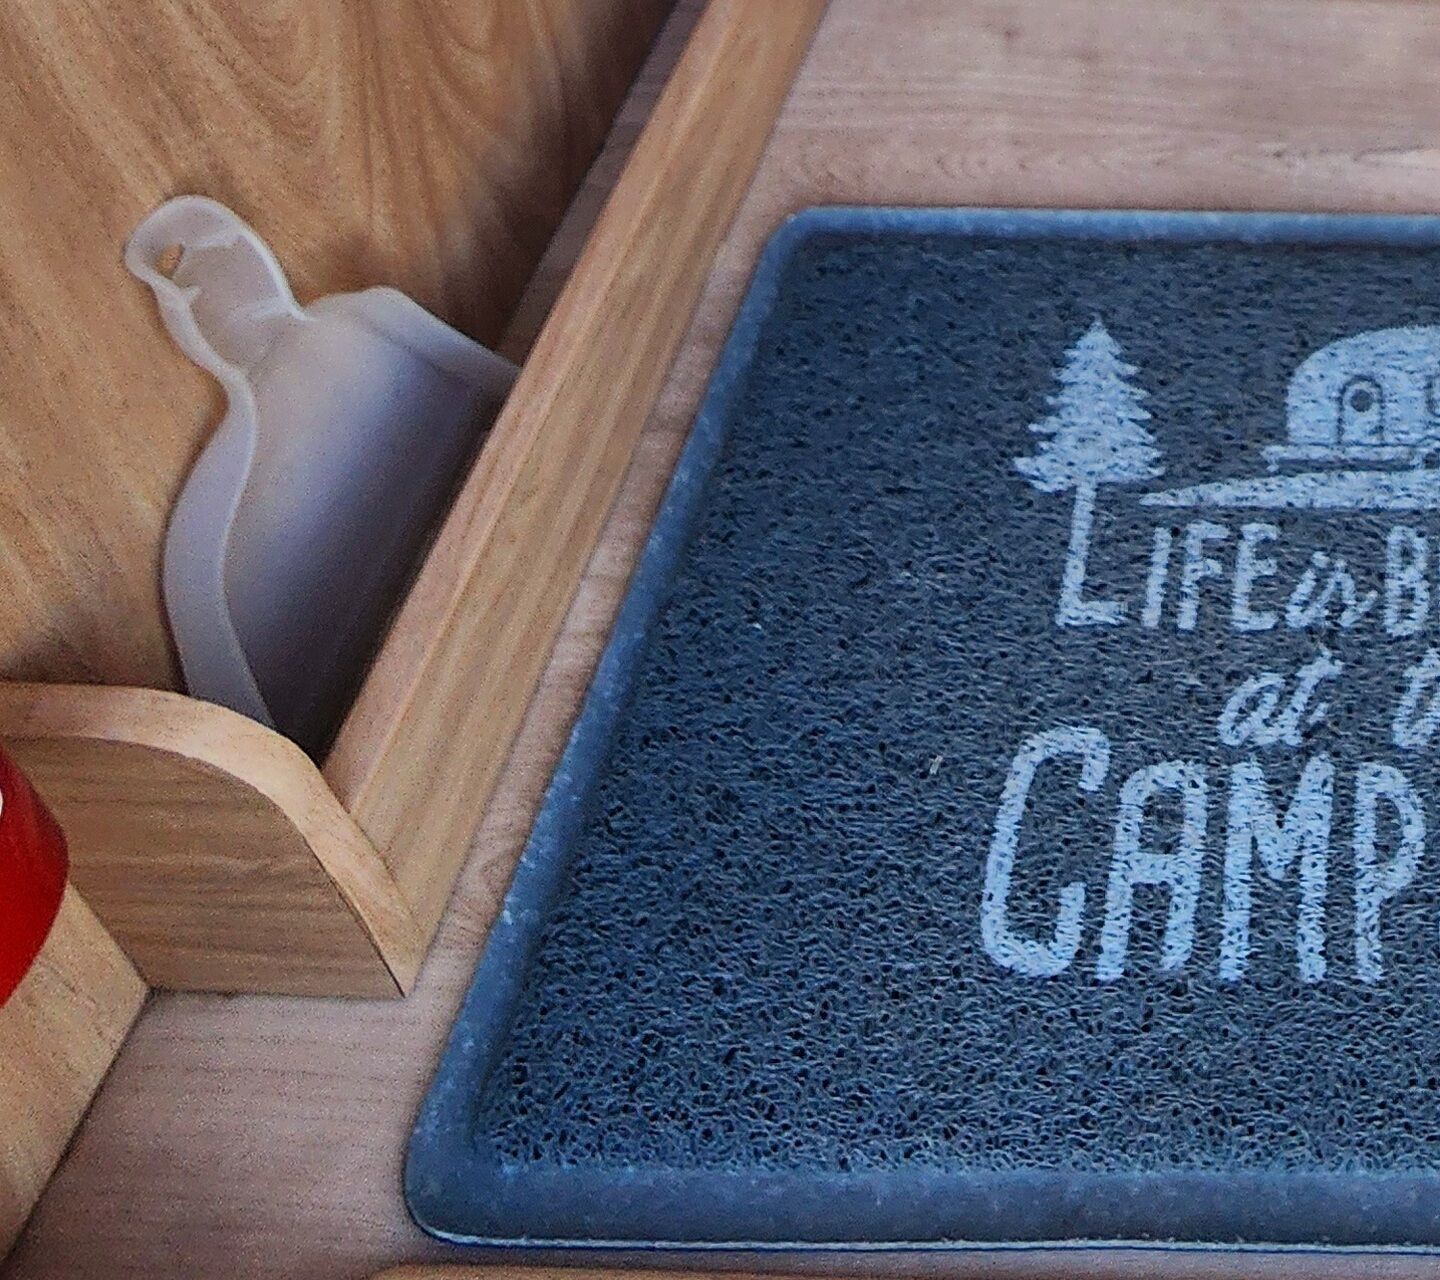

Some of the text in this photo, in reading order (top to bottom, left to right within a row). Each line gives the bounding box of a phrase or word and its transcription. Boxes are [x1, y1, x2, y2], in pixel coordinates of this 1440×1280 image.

[1057, 485, 1283, 632] LIFE
[1285, 552, 1376, 632] is
[1218, 646, 1343, 750] at
